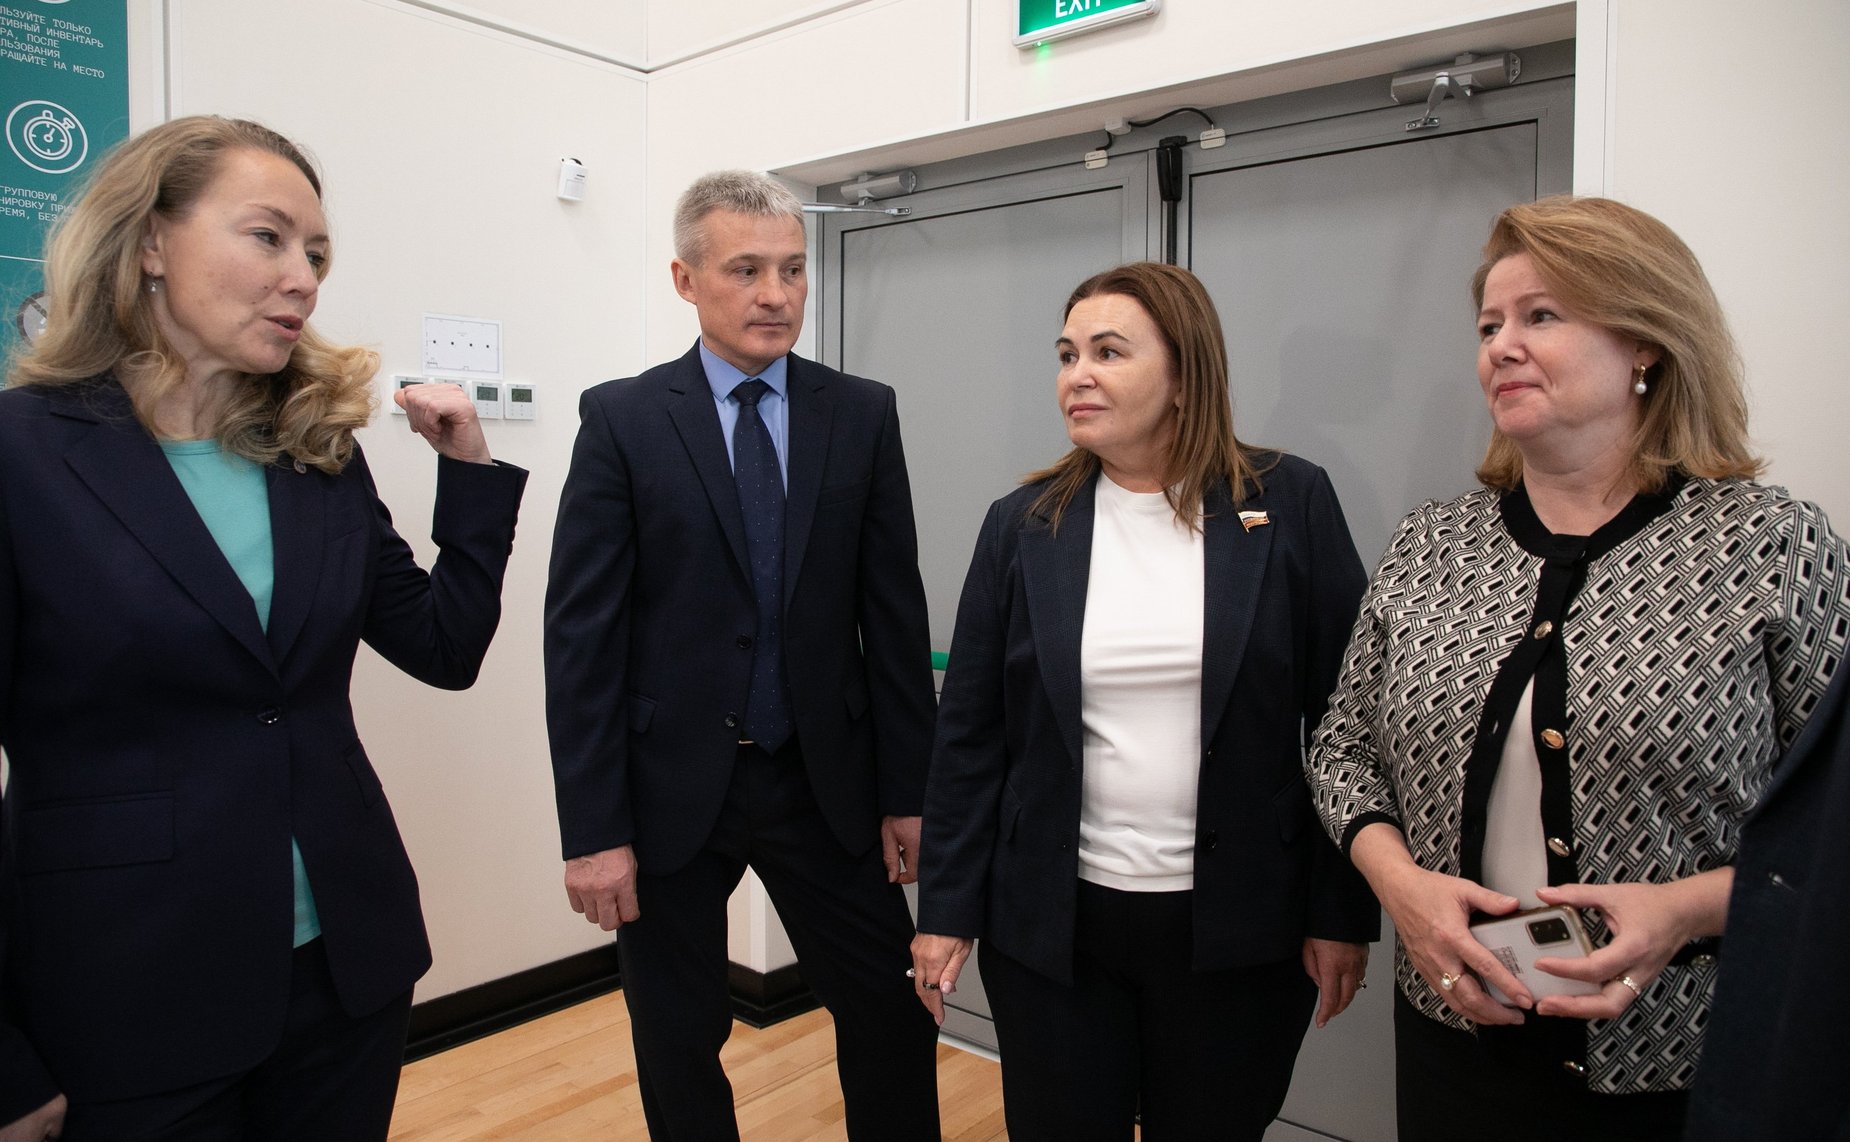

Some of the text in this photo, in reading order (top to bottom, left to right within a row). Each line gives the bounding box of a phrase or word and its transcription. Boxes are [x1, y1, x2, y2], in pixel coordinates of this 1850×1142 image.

[52, 18, 92, 35] ТОЛЬКО
[27, 33, 60, 49] ПОСЛЕ
[46, 27, 104, 48] ИНВЕНТАРЬ
[53, 60, 67, 71] НА
[72, 64, 105, 79] МЕСТО
[38, 211, 59, 222] БЕЗ
